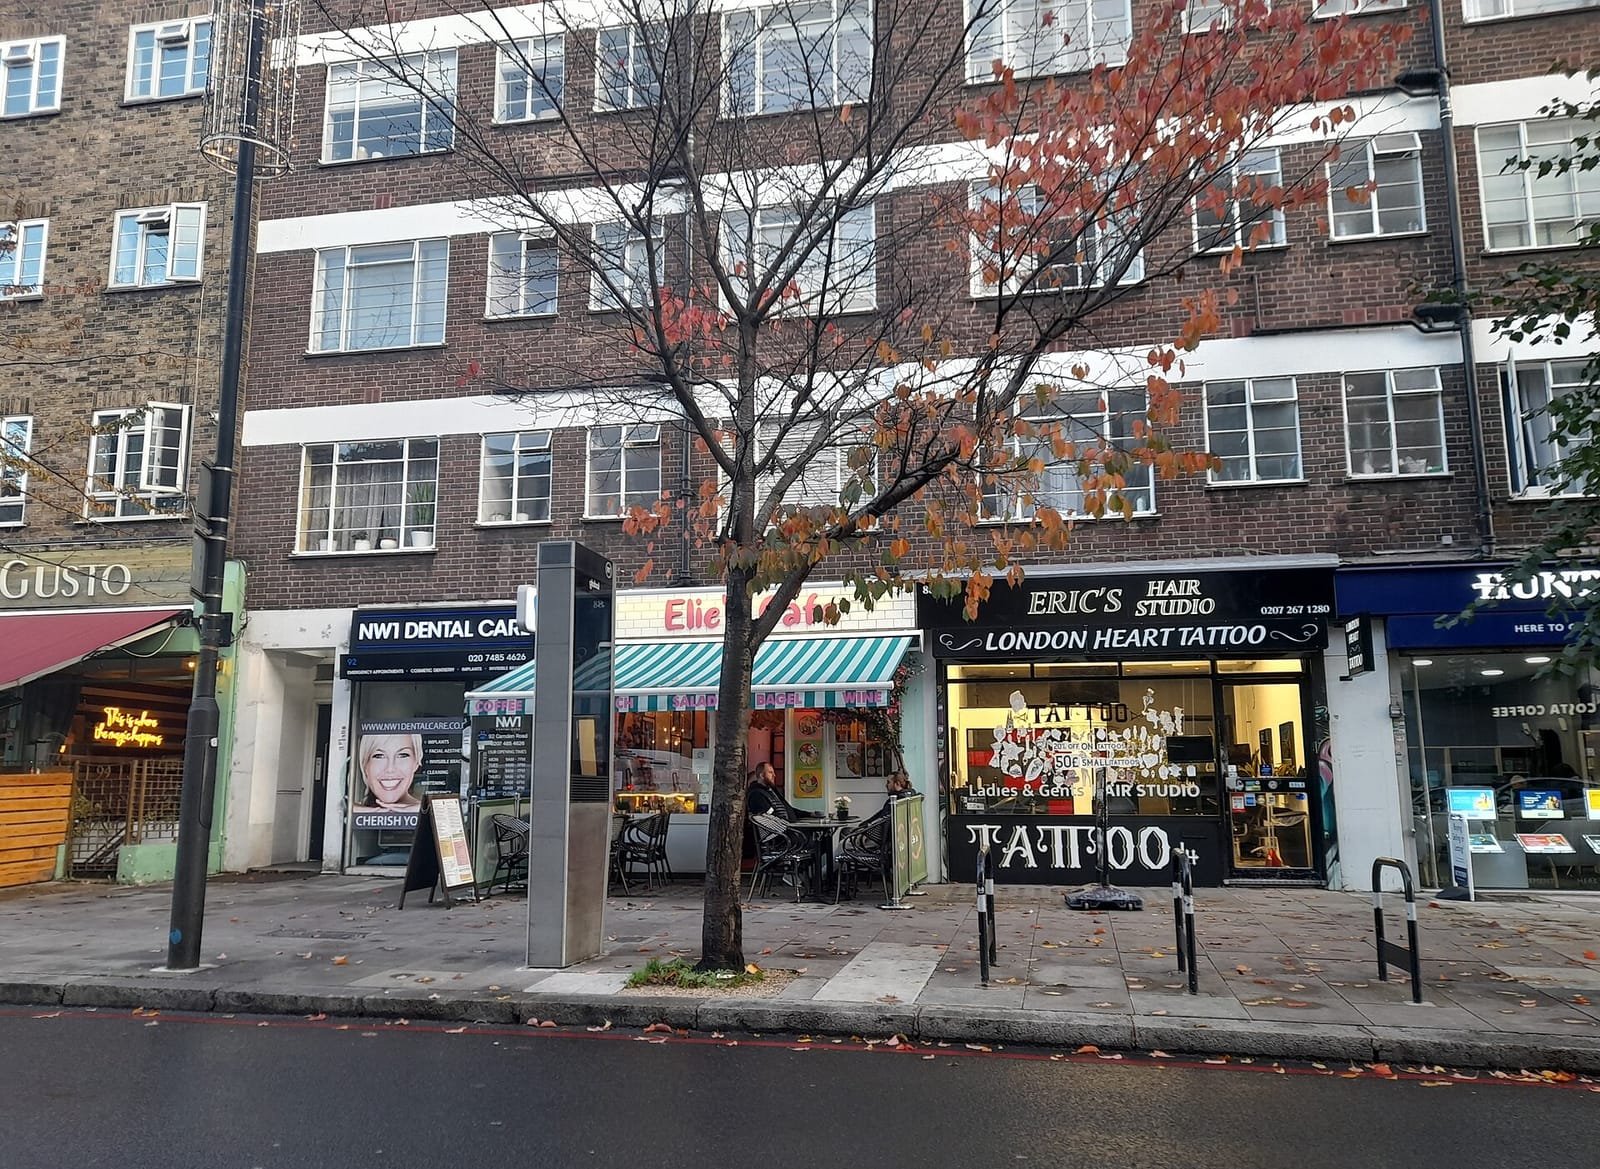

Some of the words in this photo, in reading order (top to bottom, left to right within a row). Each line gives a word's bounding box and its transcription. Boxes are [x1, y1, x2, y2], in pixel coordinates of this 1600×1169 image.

[0, 560, 131, 599] GUSTO
[1146, 579, 1202, 597] HAIR
[1028, 587, 1122, 615] ERIC'S
[1135, 598, 1216, 616] STUDIO
[665, 595, 727, 631] Elie'
[1260, 606, 1284, 614] 0207
[1286, 605, 1304, 614] 267
[1307, 604, 1330, 613] 1280
[359, 622, 399, 640] NW1
[404, 620, 474, 639] DENTAL
[1514, 624, 1544, 633] HERE
[1548, 623, 1564, 632] TO
[986, 631, 1088, 652] LONDON
[1093, 628, 1175, 650] HEART
[1178, 625, 1267, 646] TATTOO
[346, 658, 358, 666] 92
[468, 655, 483, 663] 020
[485, 654, 505, 662] 7485
[506, 653, 527, 661] 4626
[672, 695, 718, 707] SALAD
[757, 693, 803, 706] BAGEL
[842, 691, 882, 703] WINE
[475, 701, 523, 712] COFFEE
[495, 716, 521, 727] NW1
[1055, 755, 1079, 769] 50£
[969, 783, 1018, 797] Ladies
[1022, 783, 1034, 797] &
[1039, 784, 1084, 797] Gents
[1104, 784, 1136, 797] AIR
[1137, 784, 1200, 798] STUDIO
[355, 815, 402, 826] CHERISH
[403, 815, 418, 826] YO
[966, 824, 1171, 870] TATTOO
